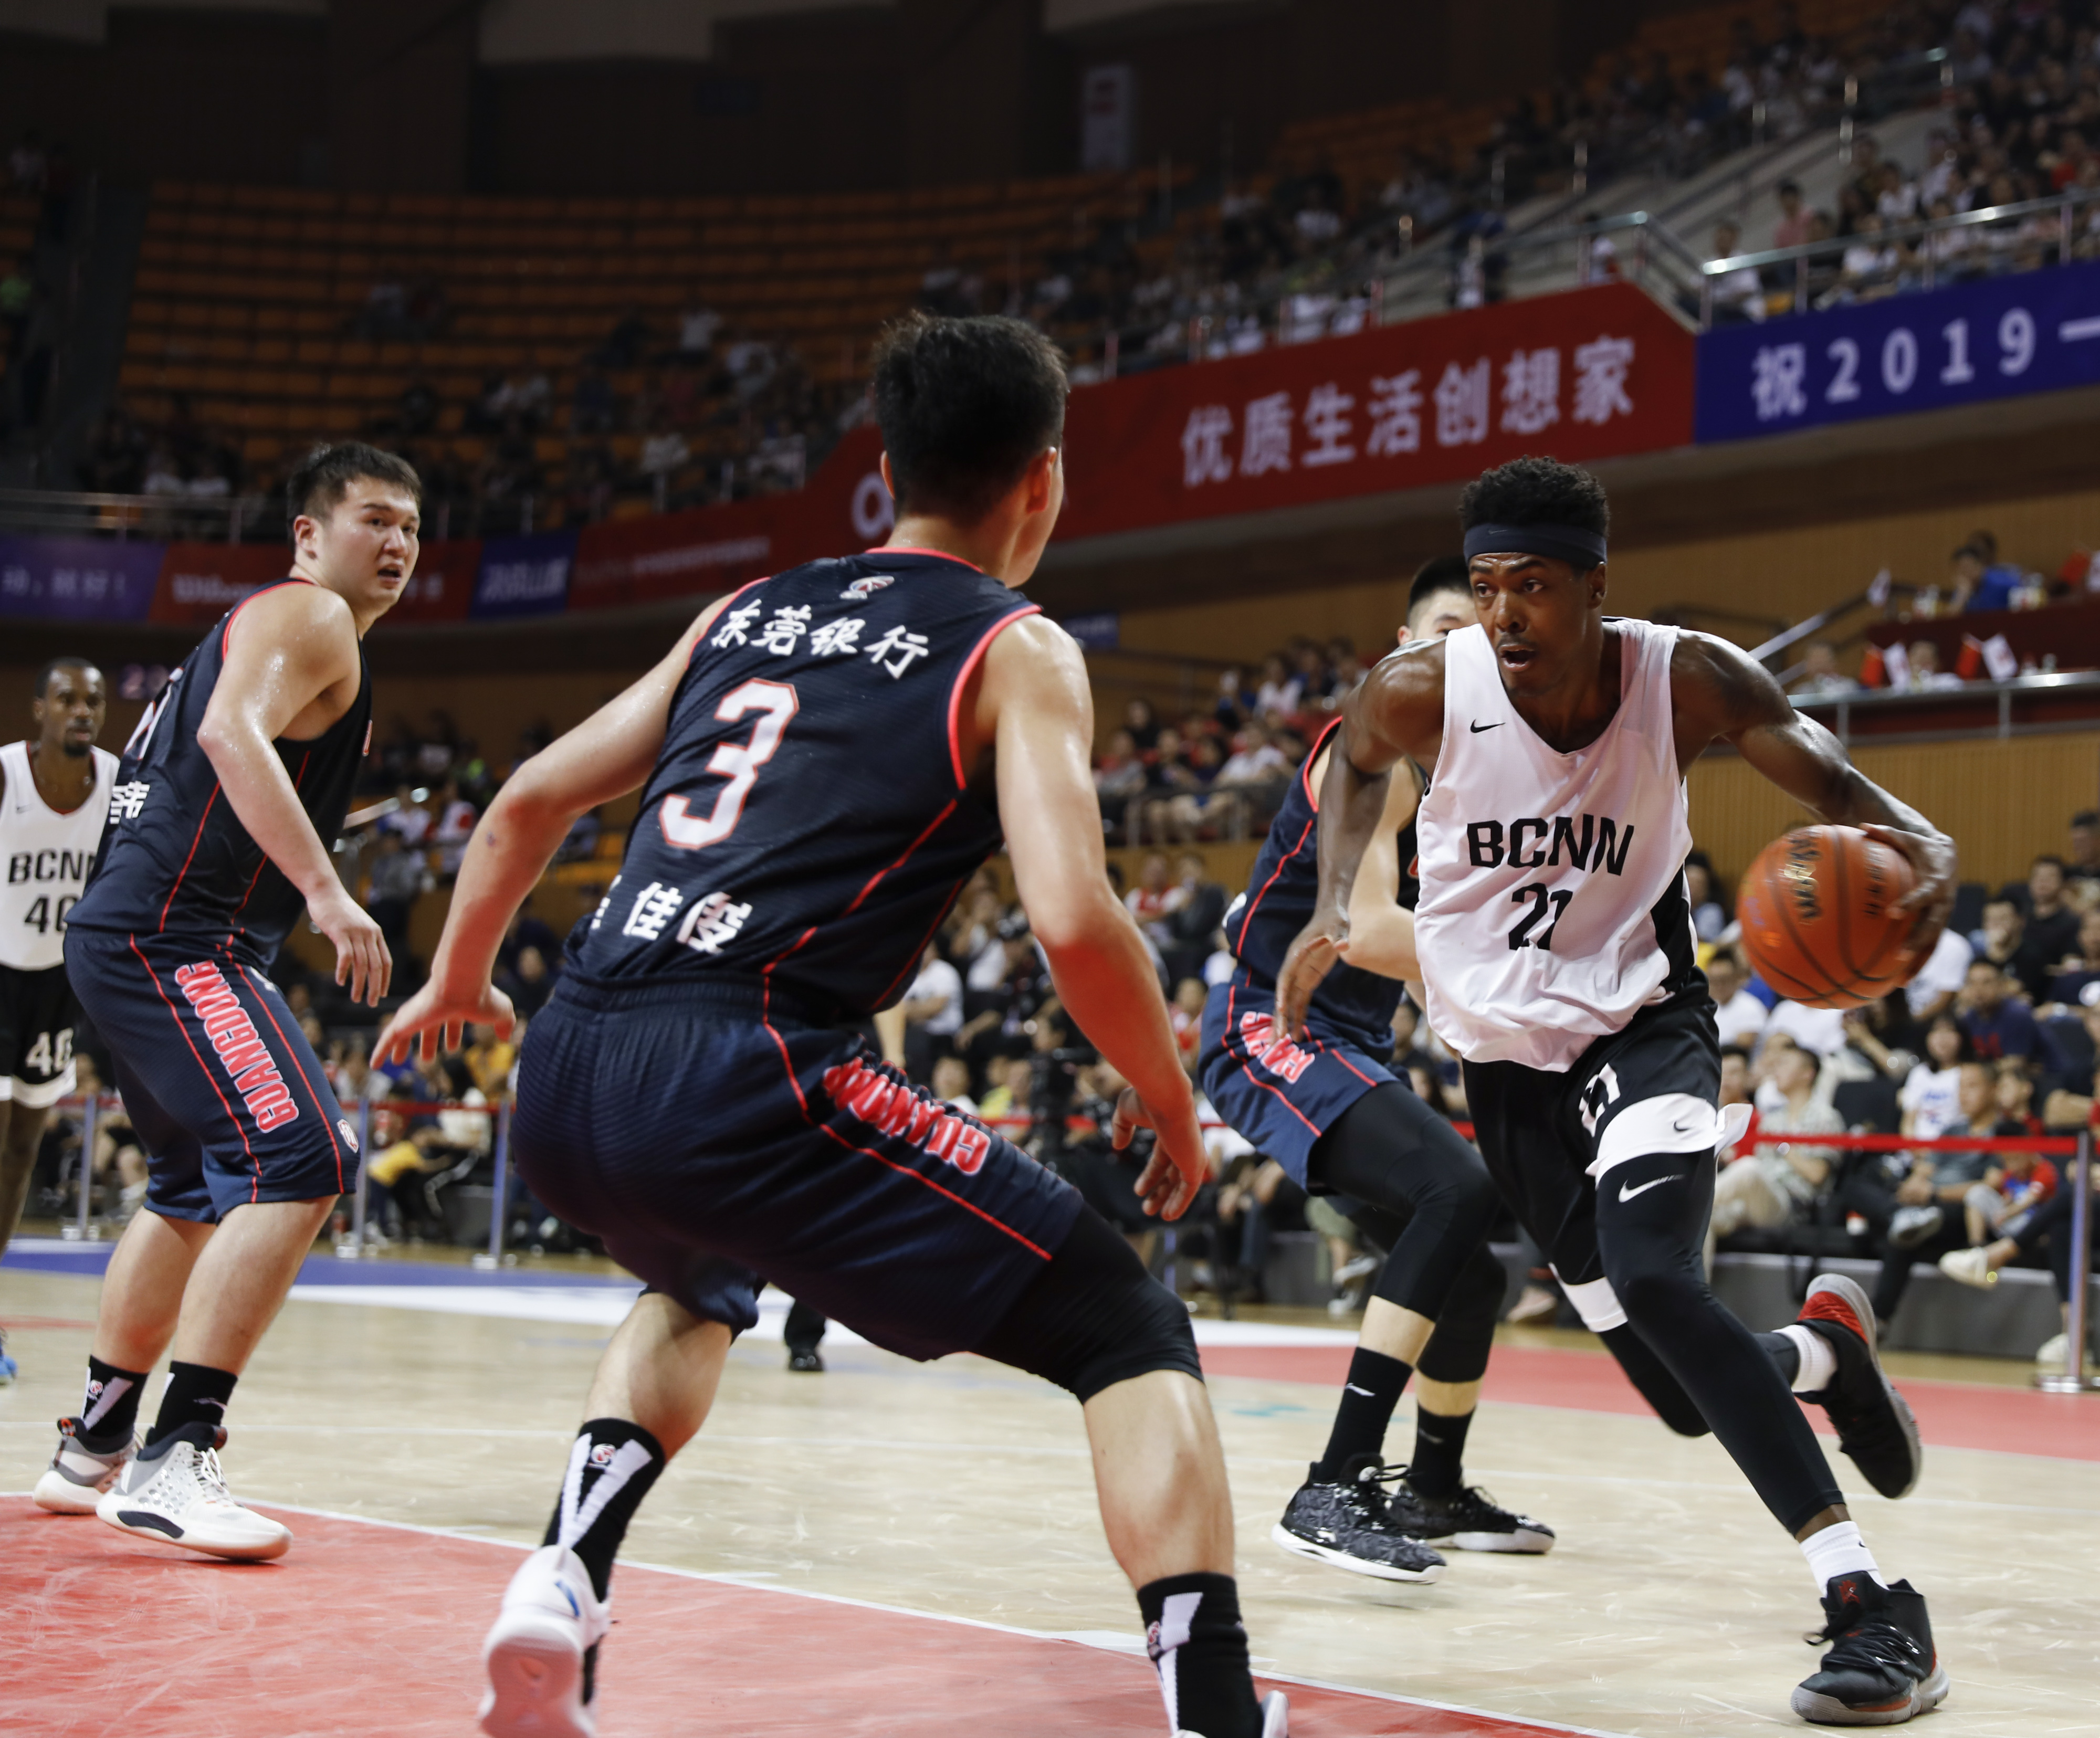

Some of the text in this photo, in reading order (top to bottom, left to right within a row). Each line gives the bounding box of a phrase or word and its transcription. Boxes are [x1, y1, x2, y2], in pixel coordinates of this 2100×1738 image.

[1181, 334, 1635, 487] 优质生活创想家
[711, 598, 929, 679] 东莞银行
[658, 678, 800, 850] 3
[1467, 814, 1634, 876] BCNN
[1508, 882, 1573, 951] 21
[175, 960, 299, 1134] GUANGDONG
